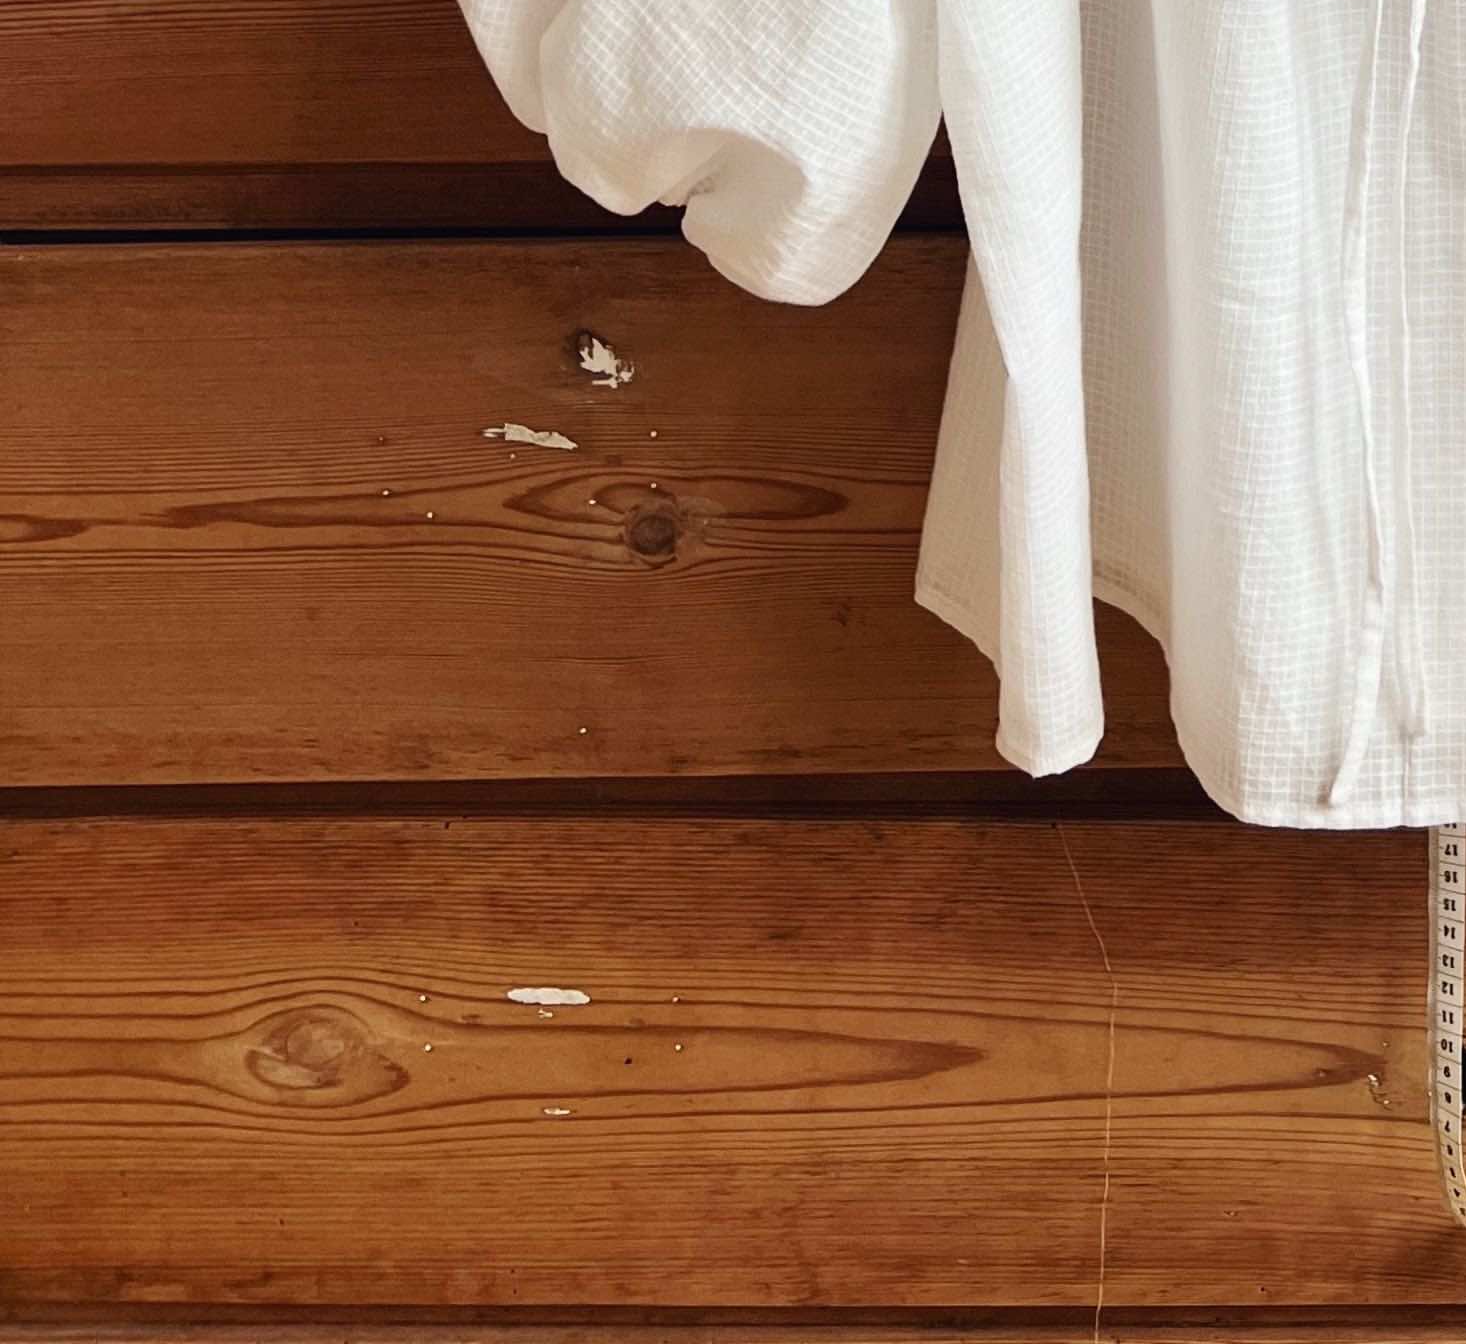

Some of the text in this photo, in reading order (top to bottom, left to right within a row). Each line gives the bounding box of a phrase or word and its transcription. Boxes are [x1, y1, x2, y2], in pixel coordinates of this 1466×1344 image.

[1444, 843, 1458, 857] 17
[1443, 925, 1456, 940] 14
[1441, 981, 1454, 996] 12
[1441, 1010, 1454, 1025] 11
[1440, 1038, 1454, 1054] 10
